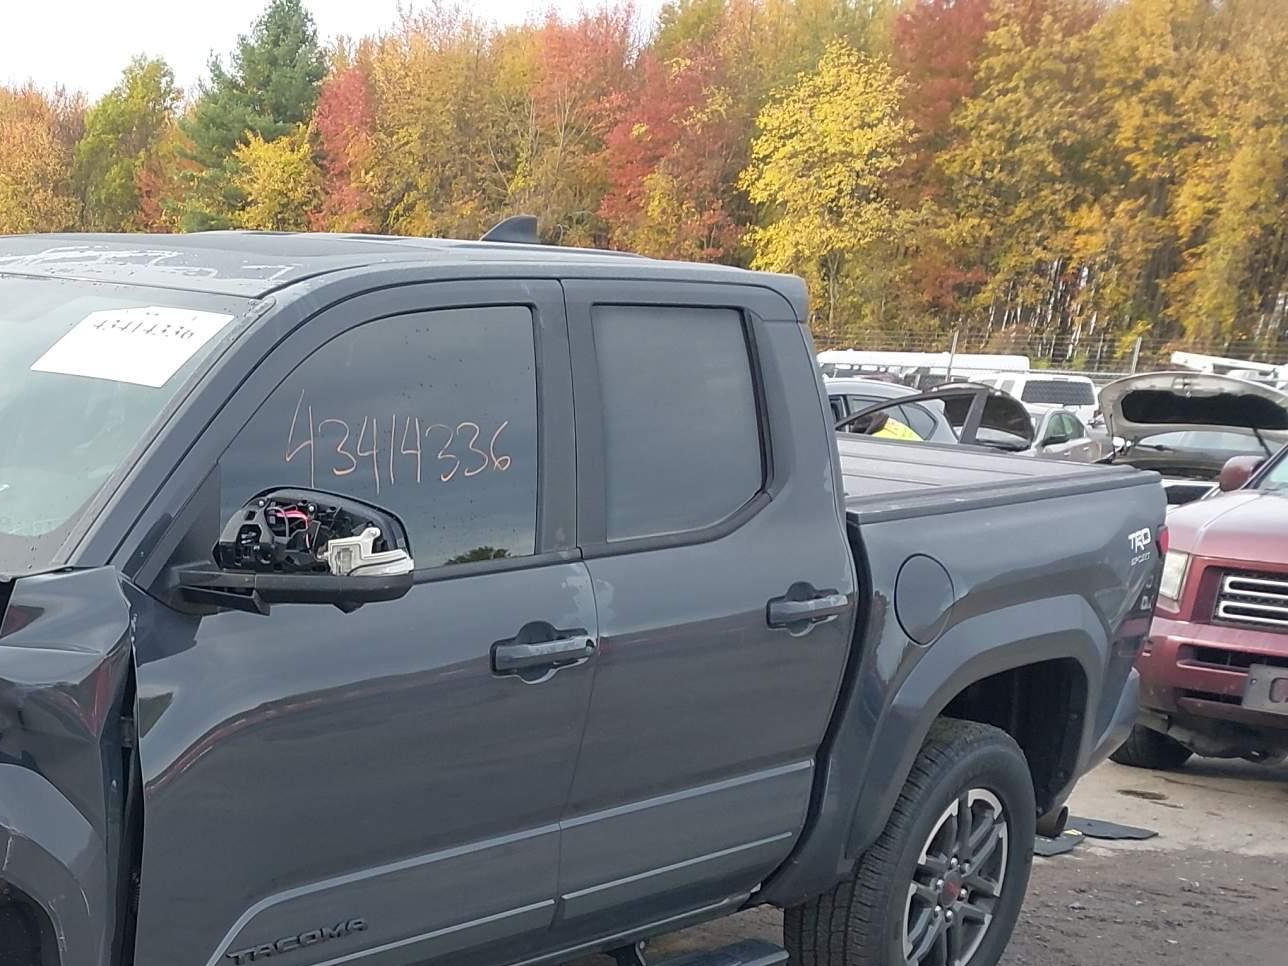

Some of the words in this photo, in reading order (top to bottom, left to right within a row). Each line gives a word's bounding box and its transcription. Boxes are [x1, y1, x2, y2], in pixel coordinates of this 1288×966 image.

[285, 388, 512, 497] 43414336
[1127, 527, 1152, 553] TRD
[225, 917, 368, 966] TACOMA
